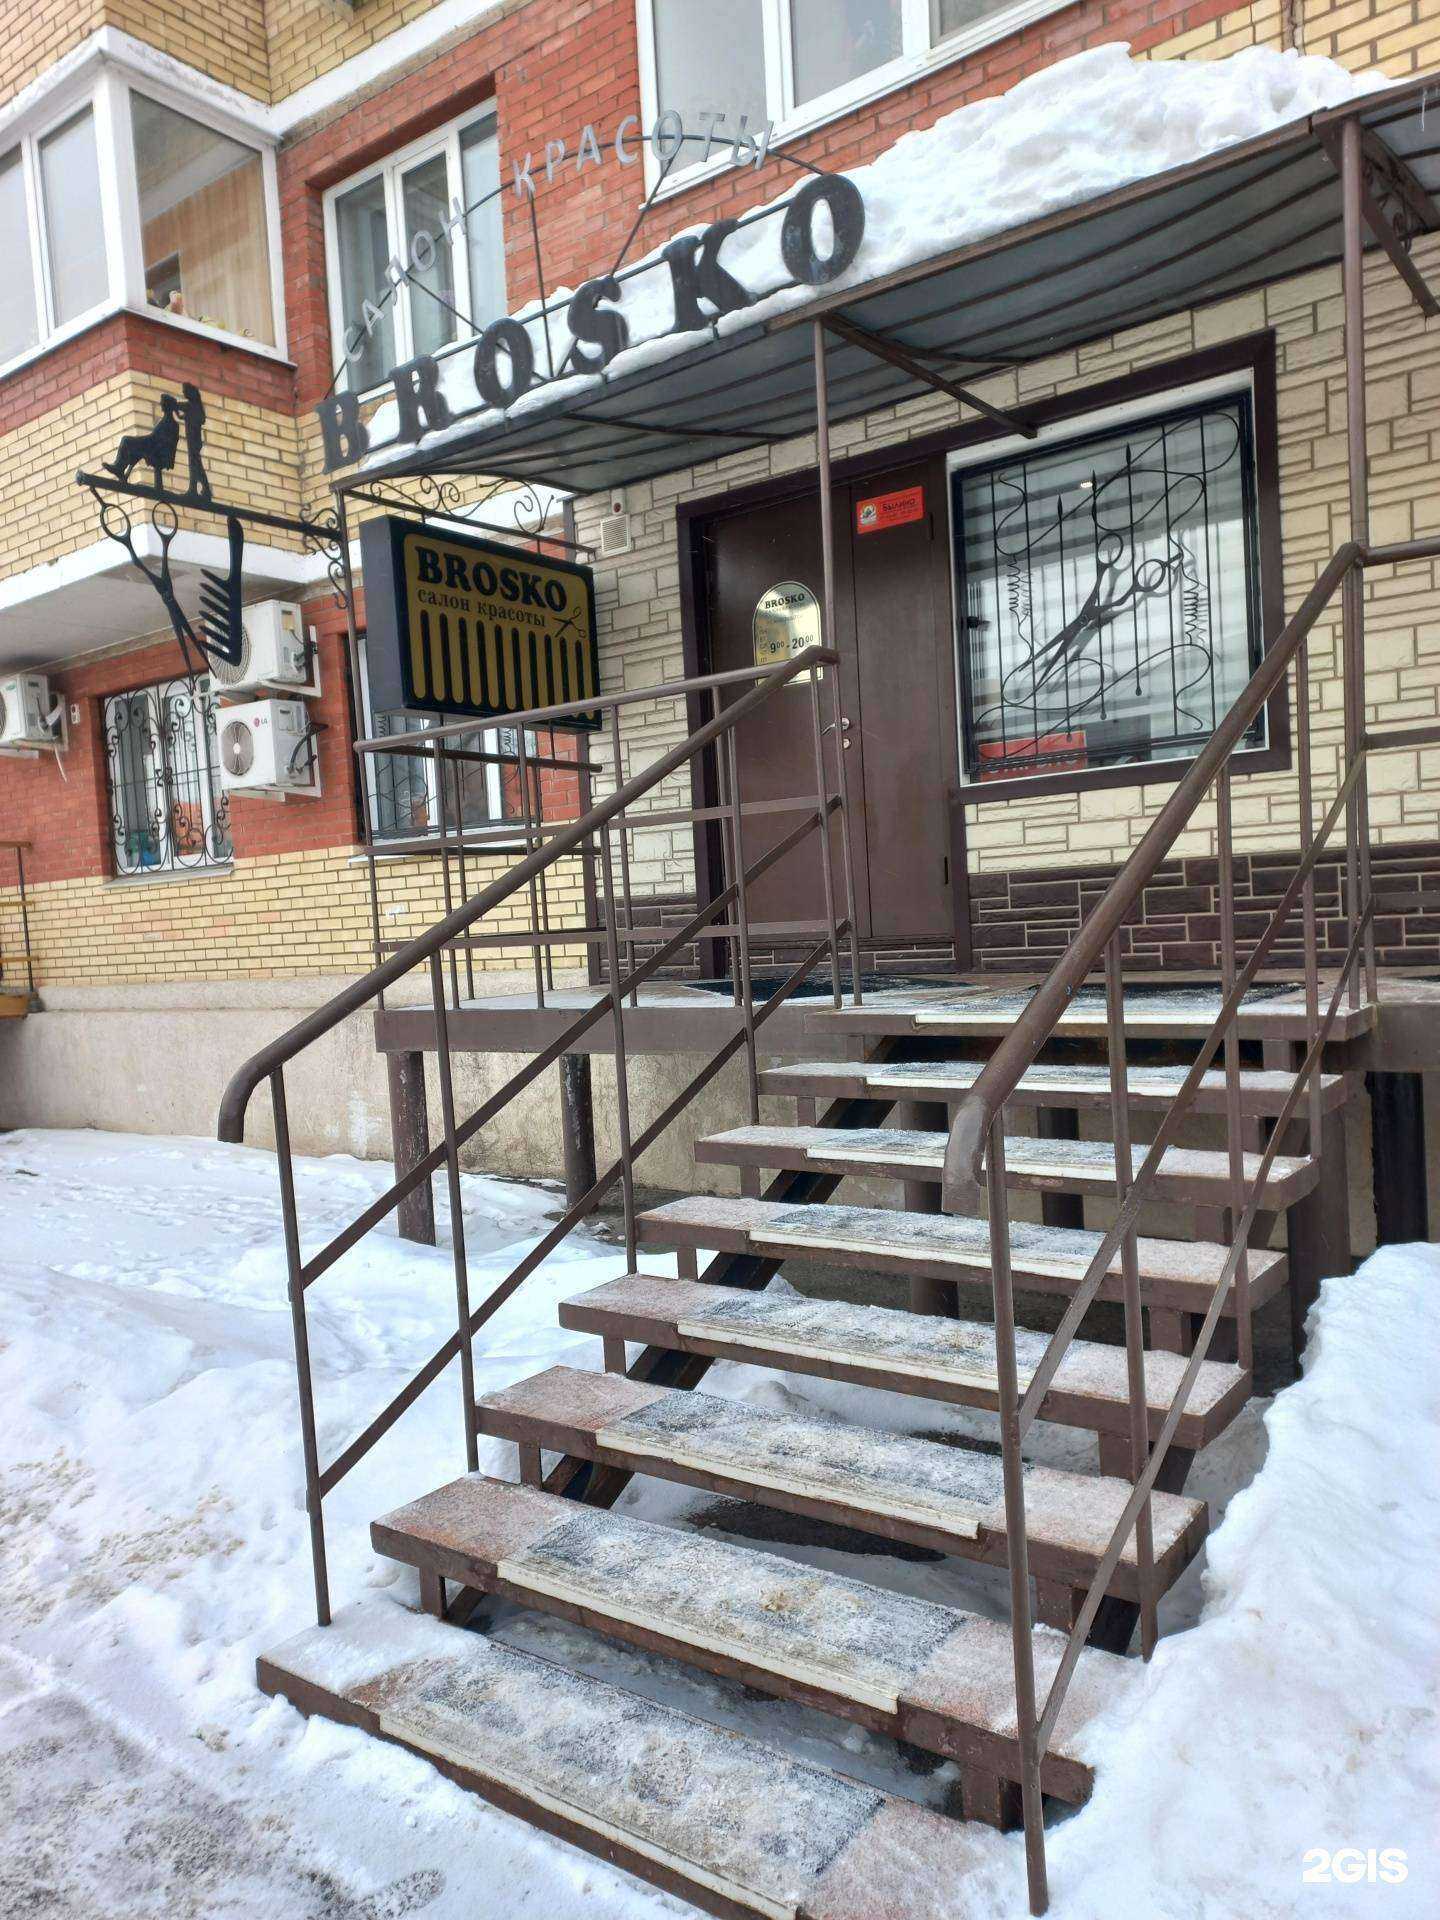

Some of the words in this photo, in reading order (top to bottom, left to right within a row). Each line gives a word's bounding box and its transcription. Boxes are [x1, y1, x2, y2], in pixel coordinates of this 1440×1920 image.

[341, 196, 468, 364] САЛОН
[513, 109, 774, 200] КРАСОТЫ
[315, 172, 866, 476] BROSKO
[415, 546, 568, 612] BROSKO
[417, 586, 470, 612] салон
[477, 600, 546, 628] красоты
[765, 593, 805, 609] BROSKO
